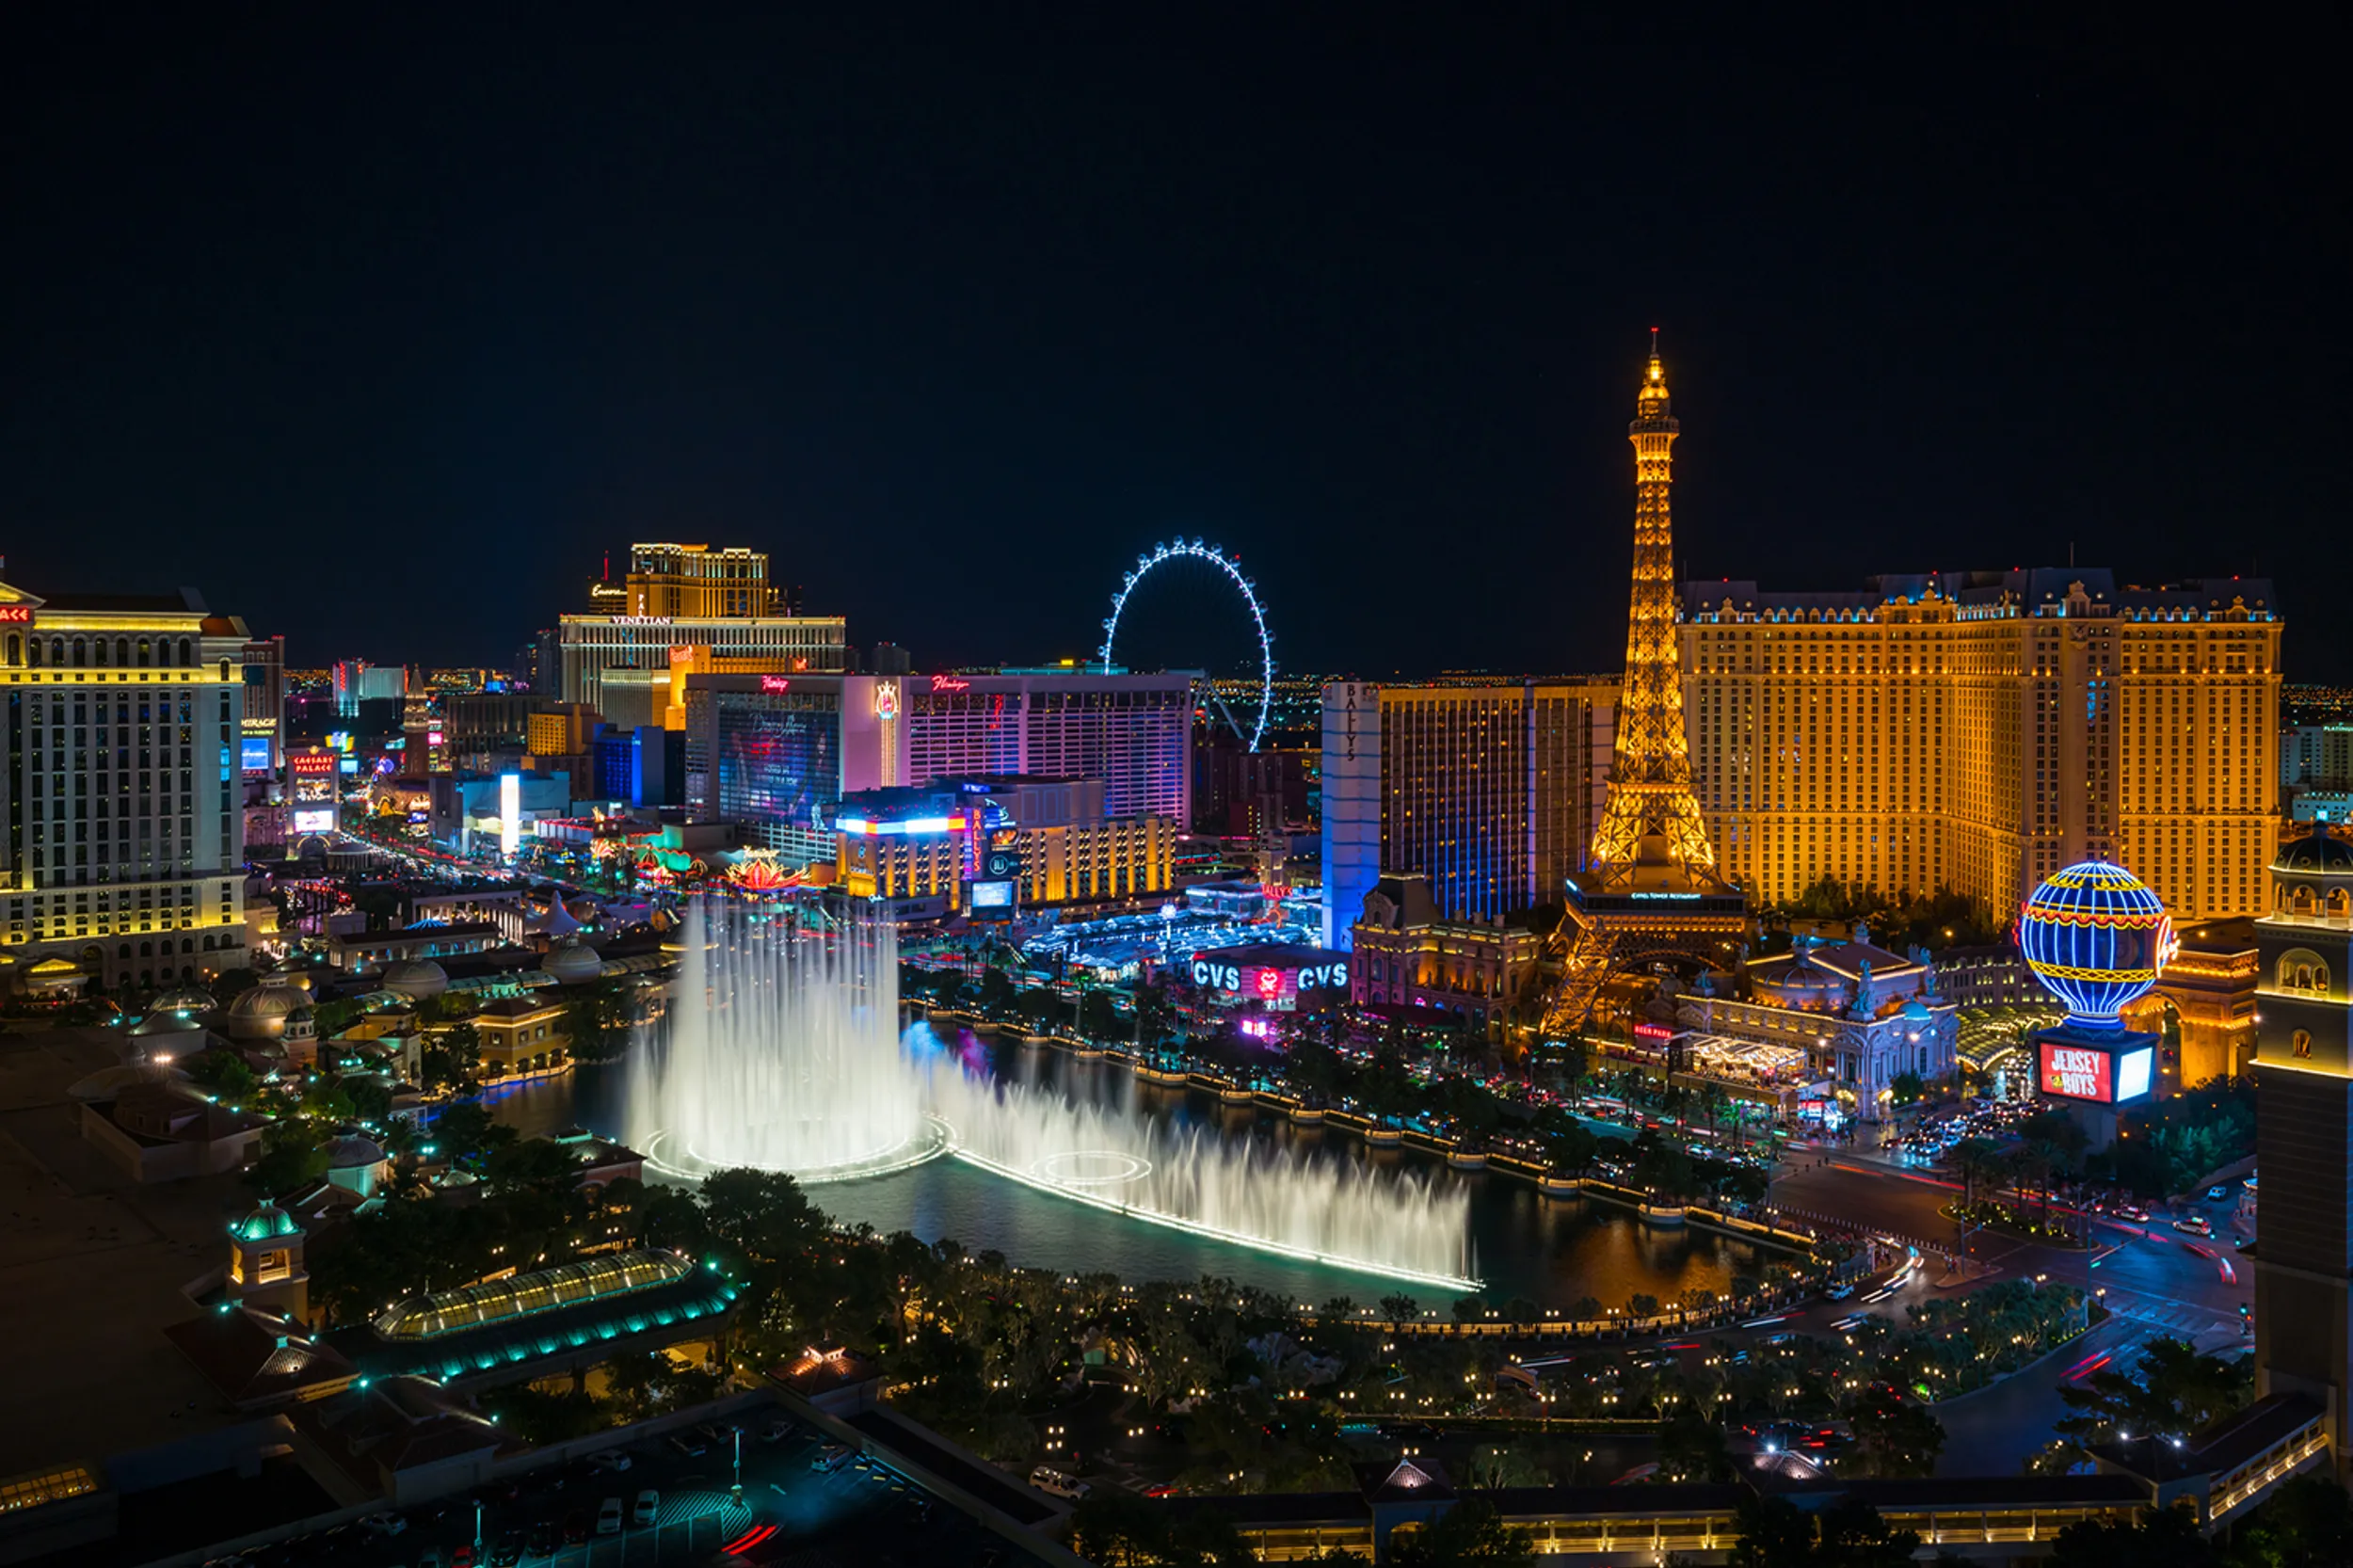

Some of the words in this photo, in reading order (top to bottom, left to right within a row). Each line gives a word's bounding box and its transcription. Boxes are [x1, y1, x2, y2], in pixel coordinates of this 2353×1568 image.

[612, 616, 671, 625] VENETIAN
[931, 675, 969, 692] Flamingo
[294, 756, 333, 765] CAESARS
[296, 764, 331, 773] PALACE
[1193, 960, 1241, 991] CVS
[1296, 962, 1349, 990] CVS
[2051, 1049, 2100, 1075] JERSEY
[2060, 1072, 2097, 1096] BOYS
